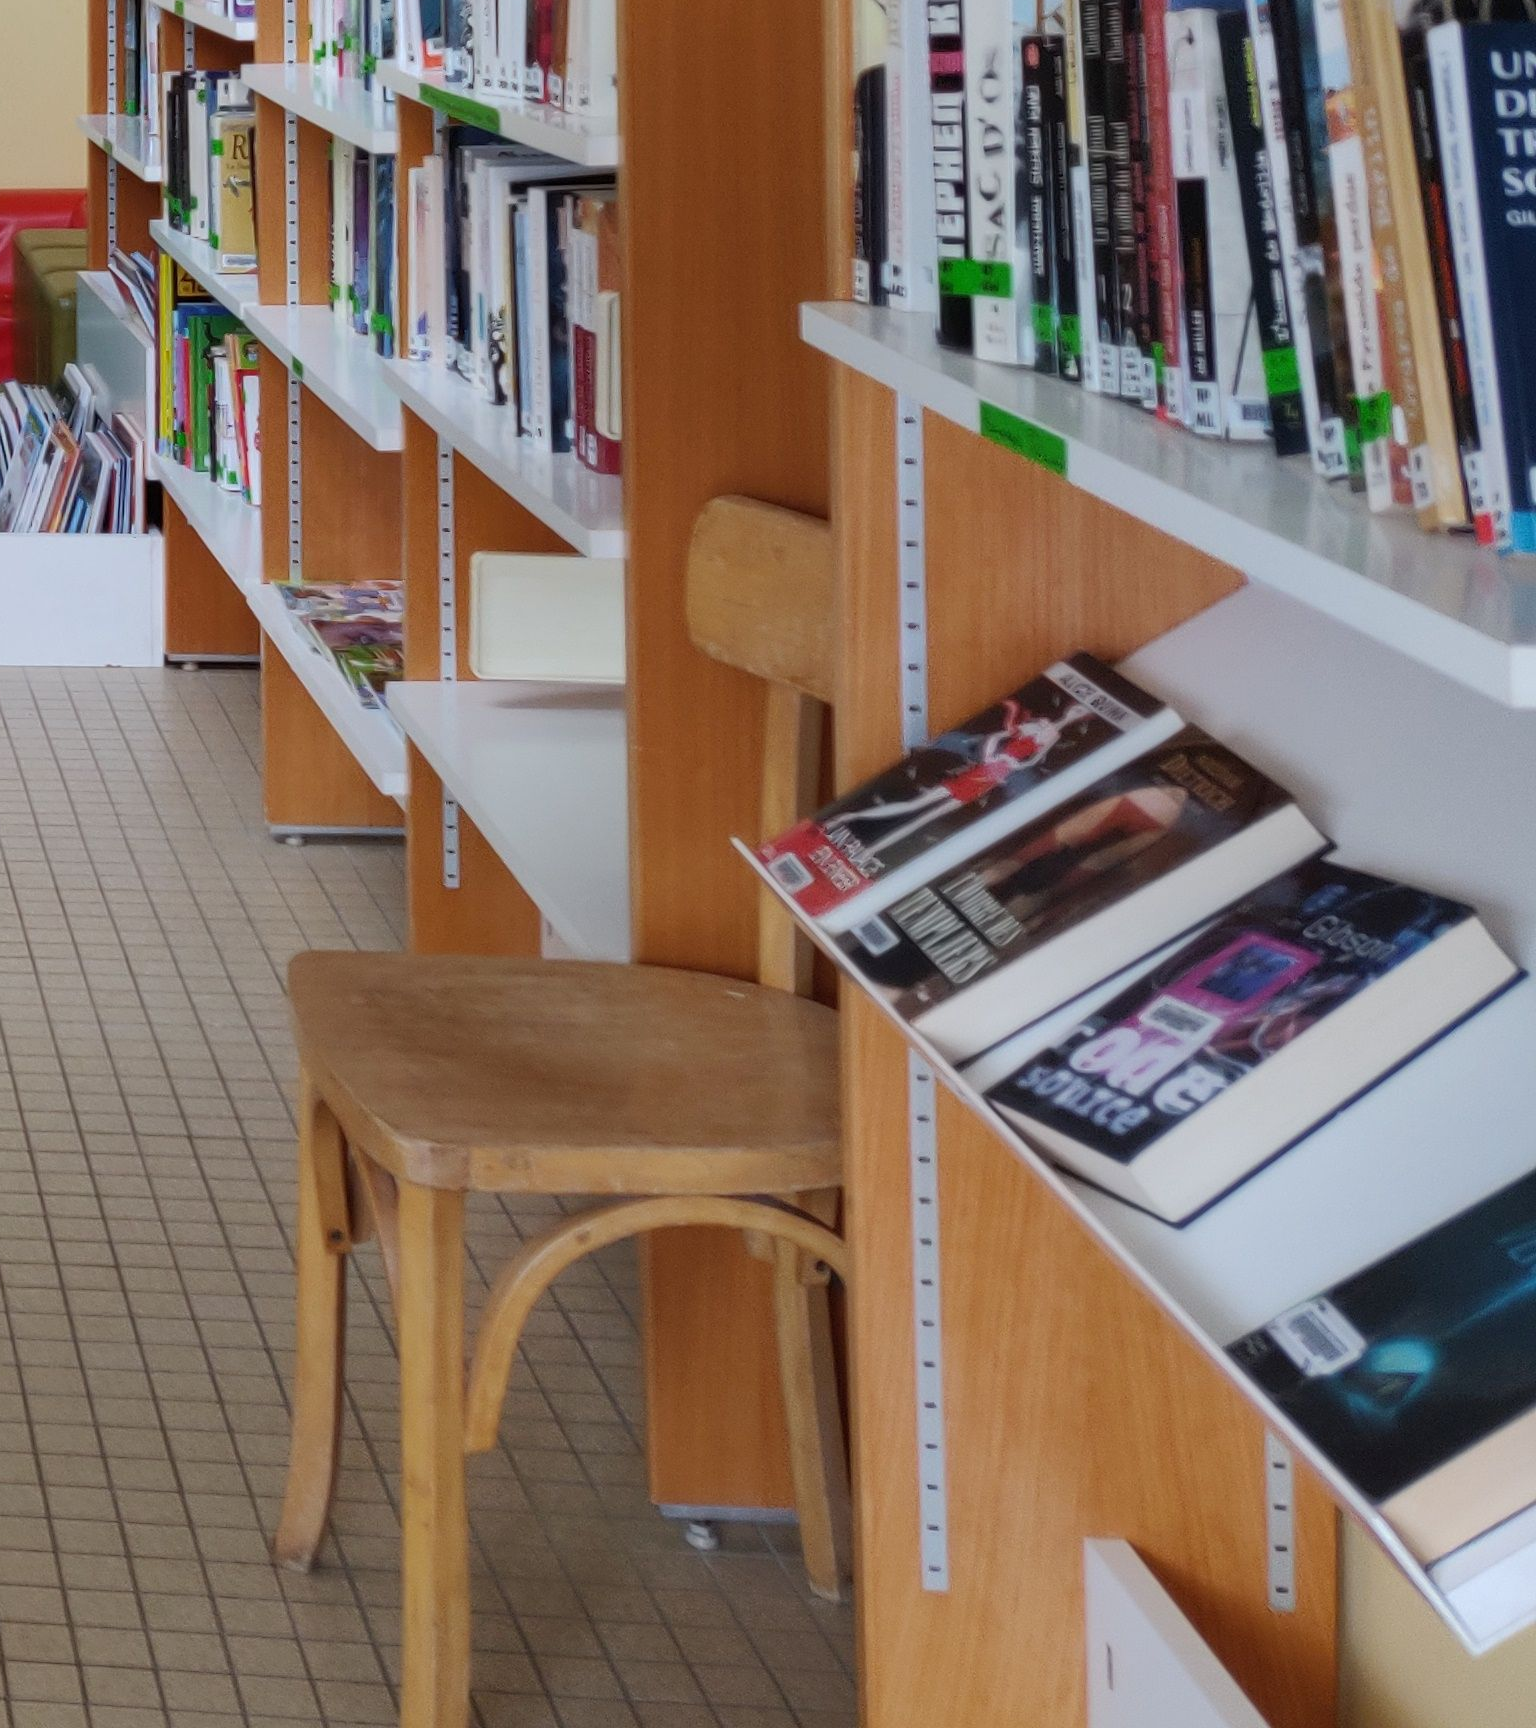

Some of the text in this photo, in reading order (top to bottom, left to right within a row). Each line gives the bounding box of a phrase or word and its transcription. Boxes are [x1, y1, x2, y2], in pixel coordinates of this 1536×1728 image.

[1081, 5, 1101, 56] Charlotte
[1104, 9, 1125, 61] Charlotte
[1025, 84, 1040, 120] KING
[930, 92, 966, 260] TEPHEN
[1088, 163, 1106, 180] du
[1110, 171, 1130, 187] du
[1301, 914, 1398, 962] Gibson
[1016, 1065, 1150, 1136] source
